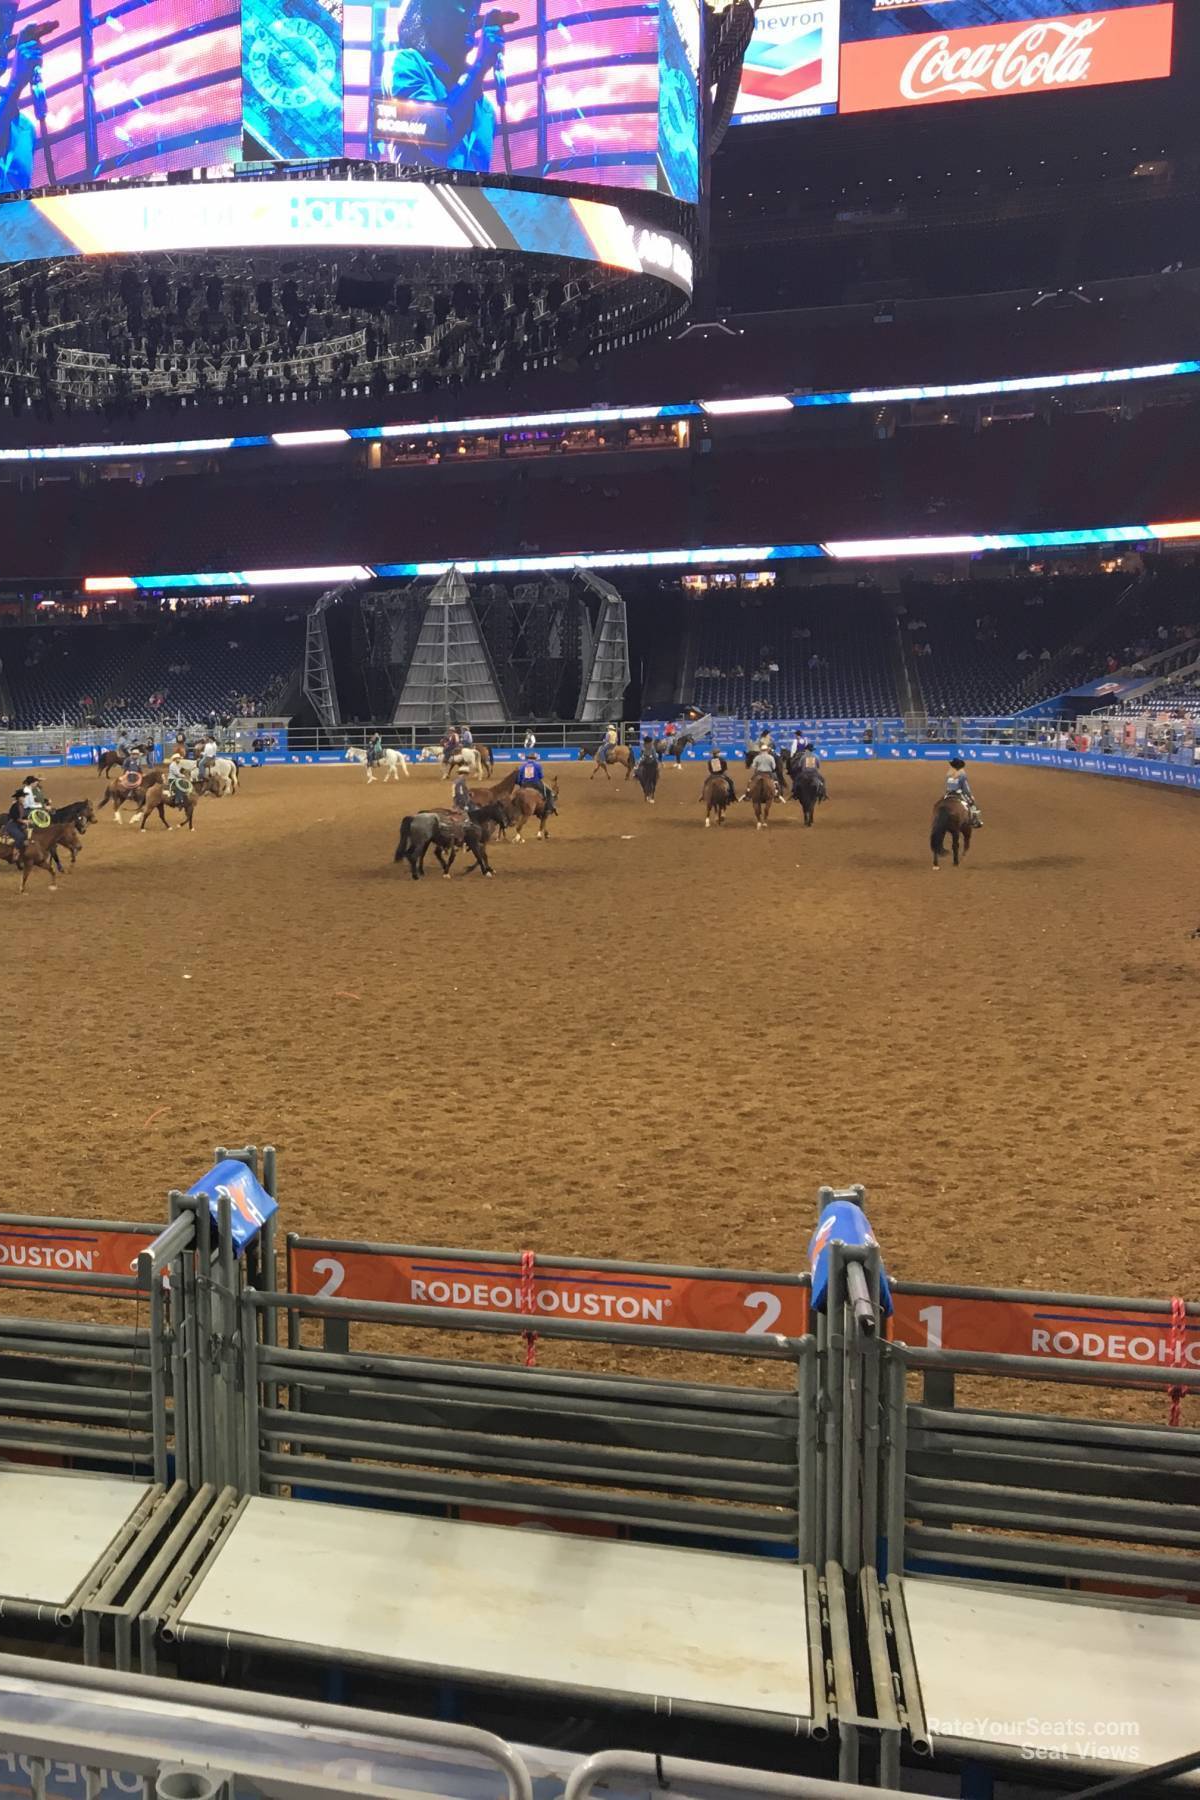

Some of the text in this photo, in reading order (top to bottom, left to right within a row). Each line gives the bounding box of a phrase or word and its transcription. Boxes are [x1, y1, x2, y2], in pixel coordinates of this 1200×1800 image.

[754, 9, 824, 32] hevron
[900, 17, 1106, 100] Coca-Cola
[312, 1257, 346, 1298] 2
[410, 1279, 663, 1321] RODEOHOUSTON
[743, 1291, 782, 1334] 2
[918, 1305, 943, 1350] 1
